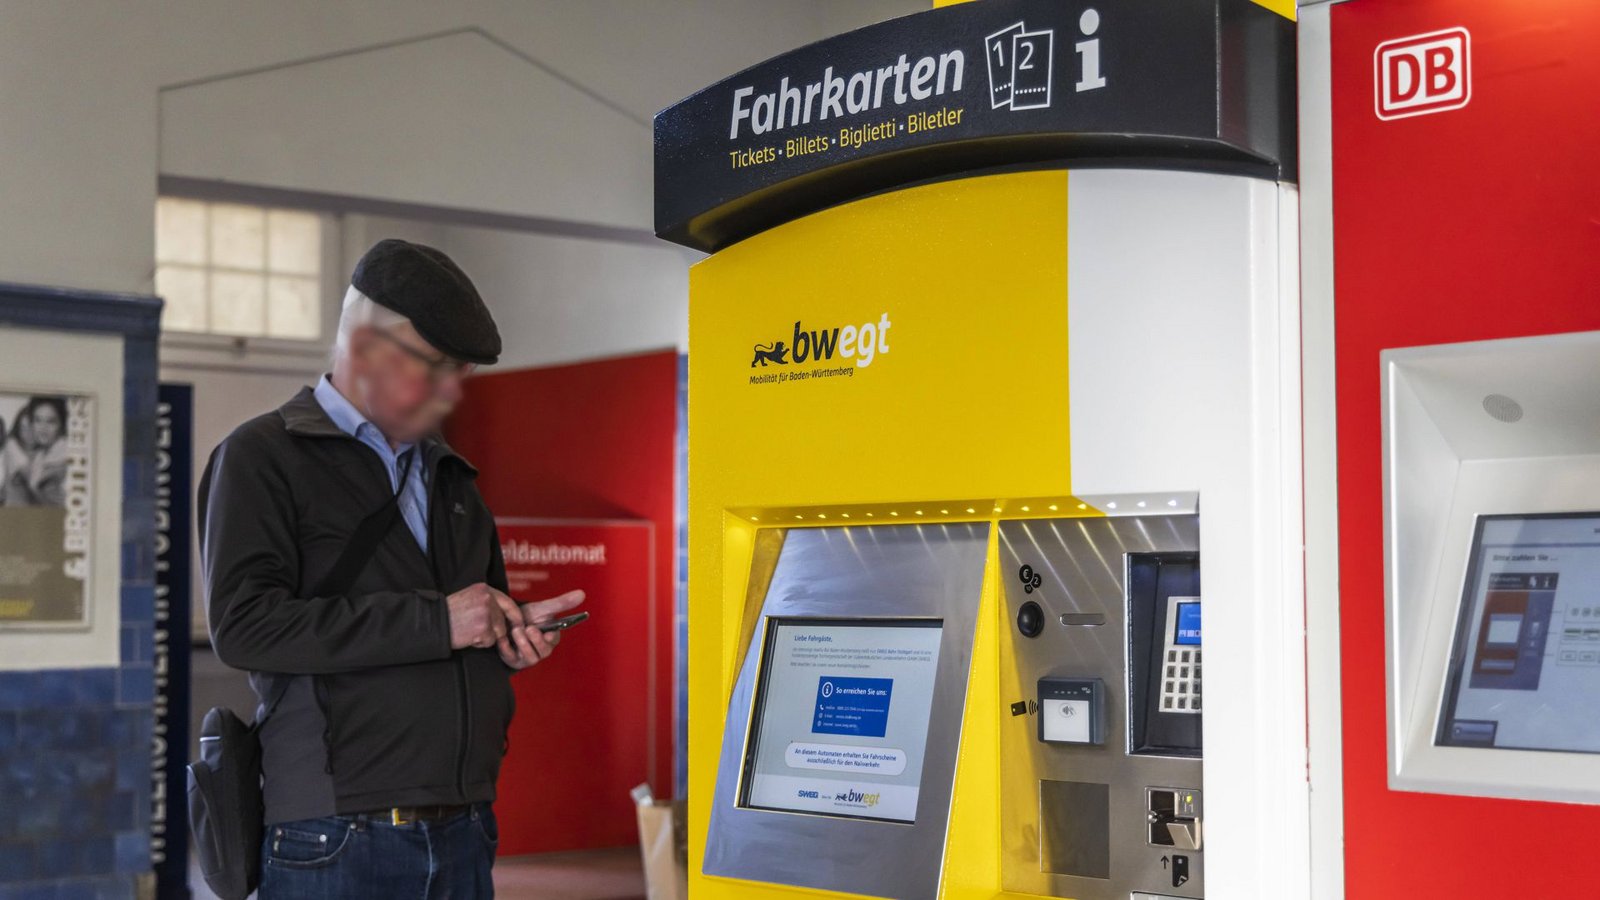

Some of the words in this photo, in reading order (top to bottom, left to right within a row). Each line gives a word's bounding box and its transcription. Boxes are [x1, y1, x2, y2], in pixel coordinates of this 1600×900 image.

[1019, 42, 1034, 70] 2
[1389, 46, 1456, 104] DB
[730, 50, 964, 140] Fahrkarten
[730, 146, 776, 169] Tickets
[786, 136, 829, 158] Billets
[840, 119, 896, 149] Biglietti
[908, 109, 964, 134] Biletler
[792, 313, 891, 368] bwegt
[750, 373, 777, 384] Mobilität
[778, 372, 788, 384] für
[790, 367, 854, 380] Baden-Württemberg
[501, 539, 606, 564] eldautomat
[870, 753, 897, 761] Fahrscheine
[848, 789, 880, 806] bwegt
